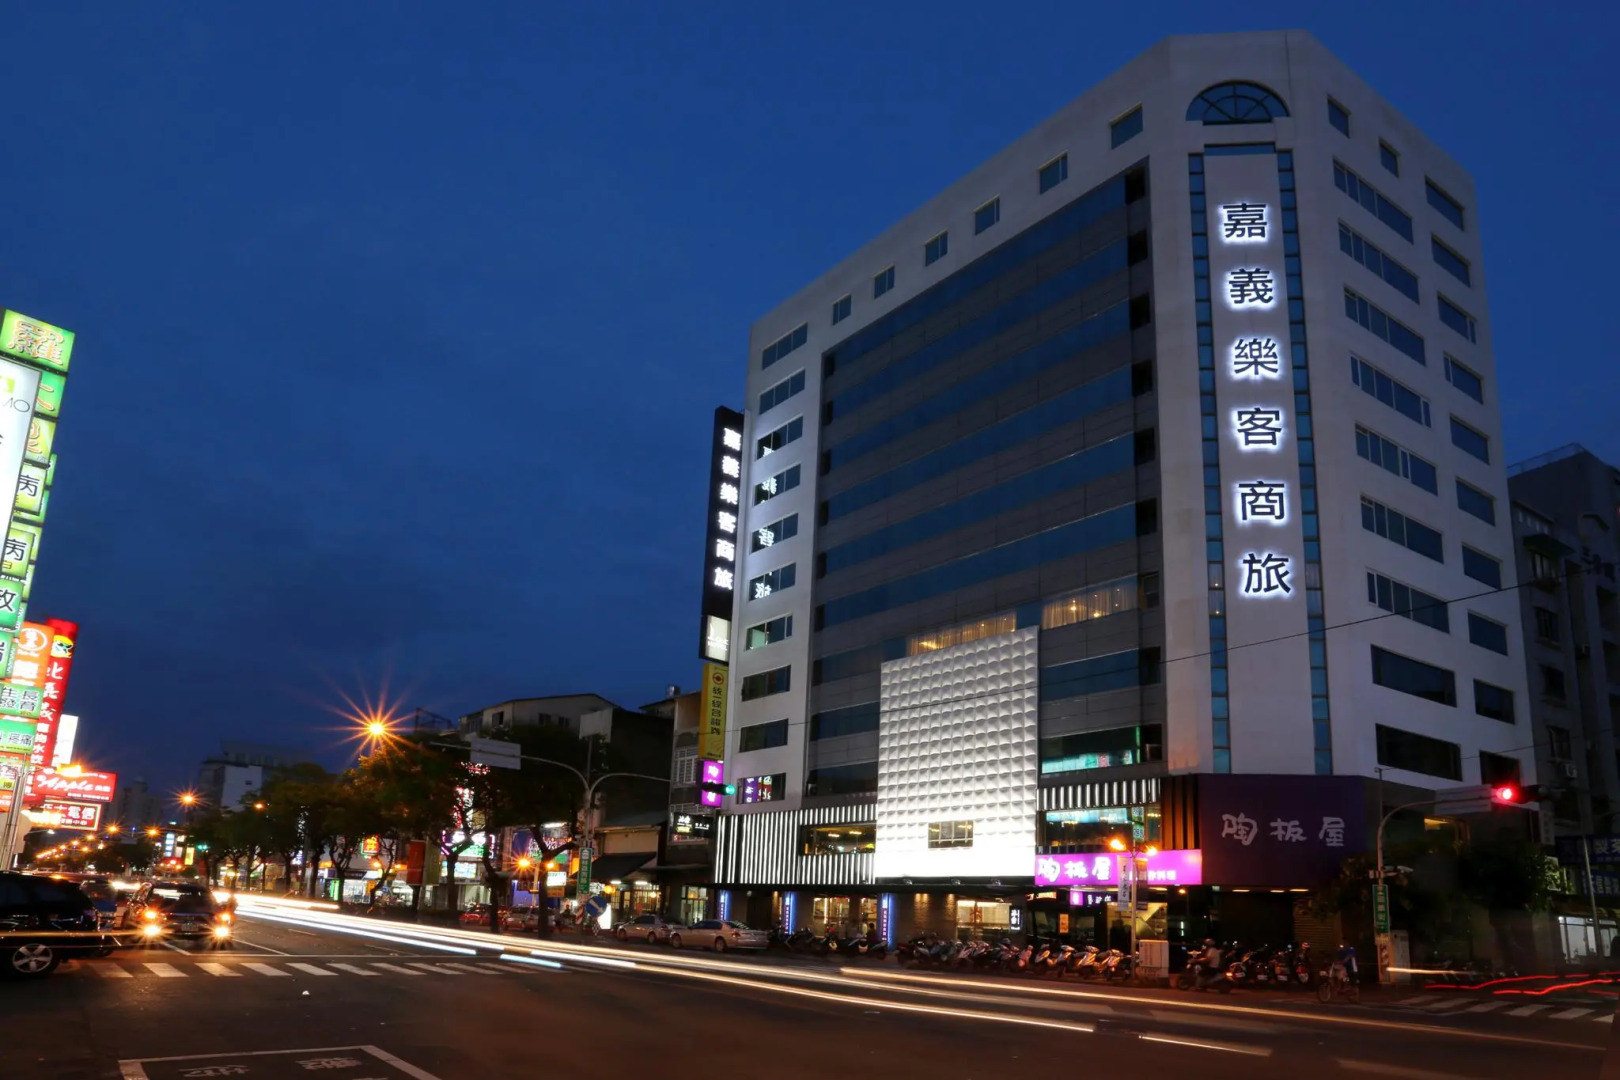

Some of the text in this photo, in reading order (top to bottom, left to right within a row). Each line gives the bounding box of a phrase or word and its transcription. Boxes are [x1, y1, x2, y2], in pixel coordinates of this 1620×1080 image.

[1221, 202, 1292, 596] 嘉義樂客商旅
[38, 776, 94, 791] Apple
[706, 764, 720, 803] 陶屋
[1220, 812, 1347, 848] 陶板屋
[1037, 856, 1112, 883] 陶板屋
